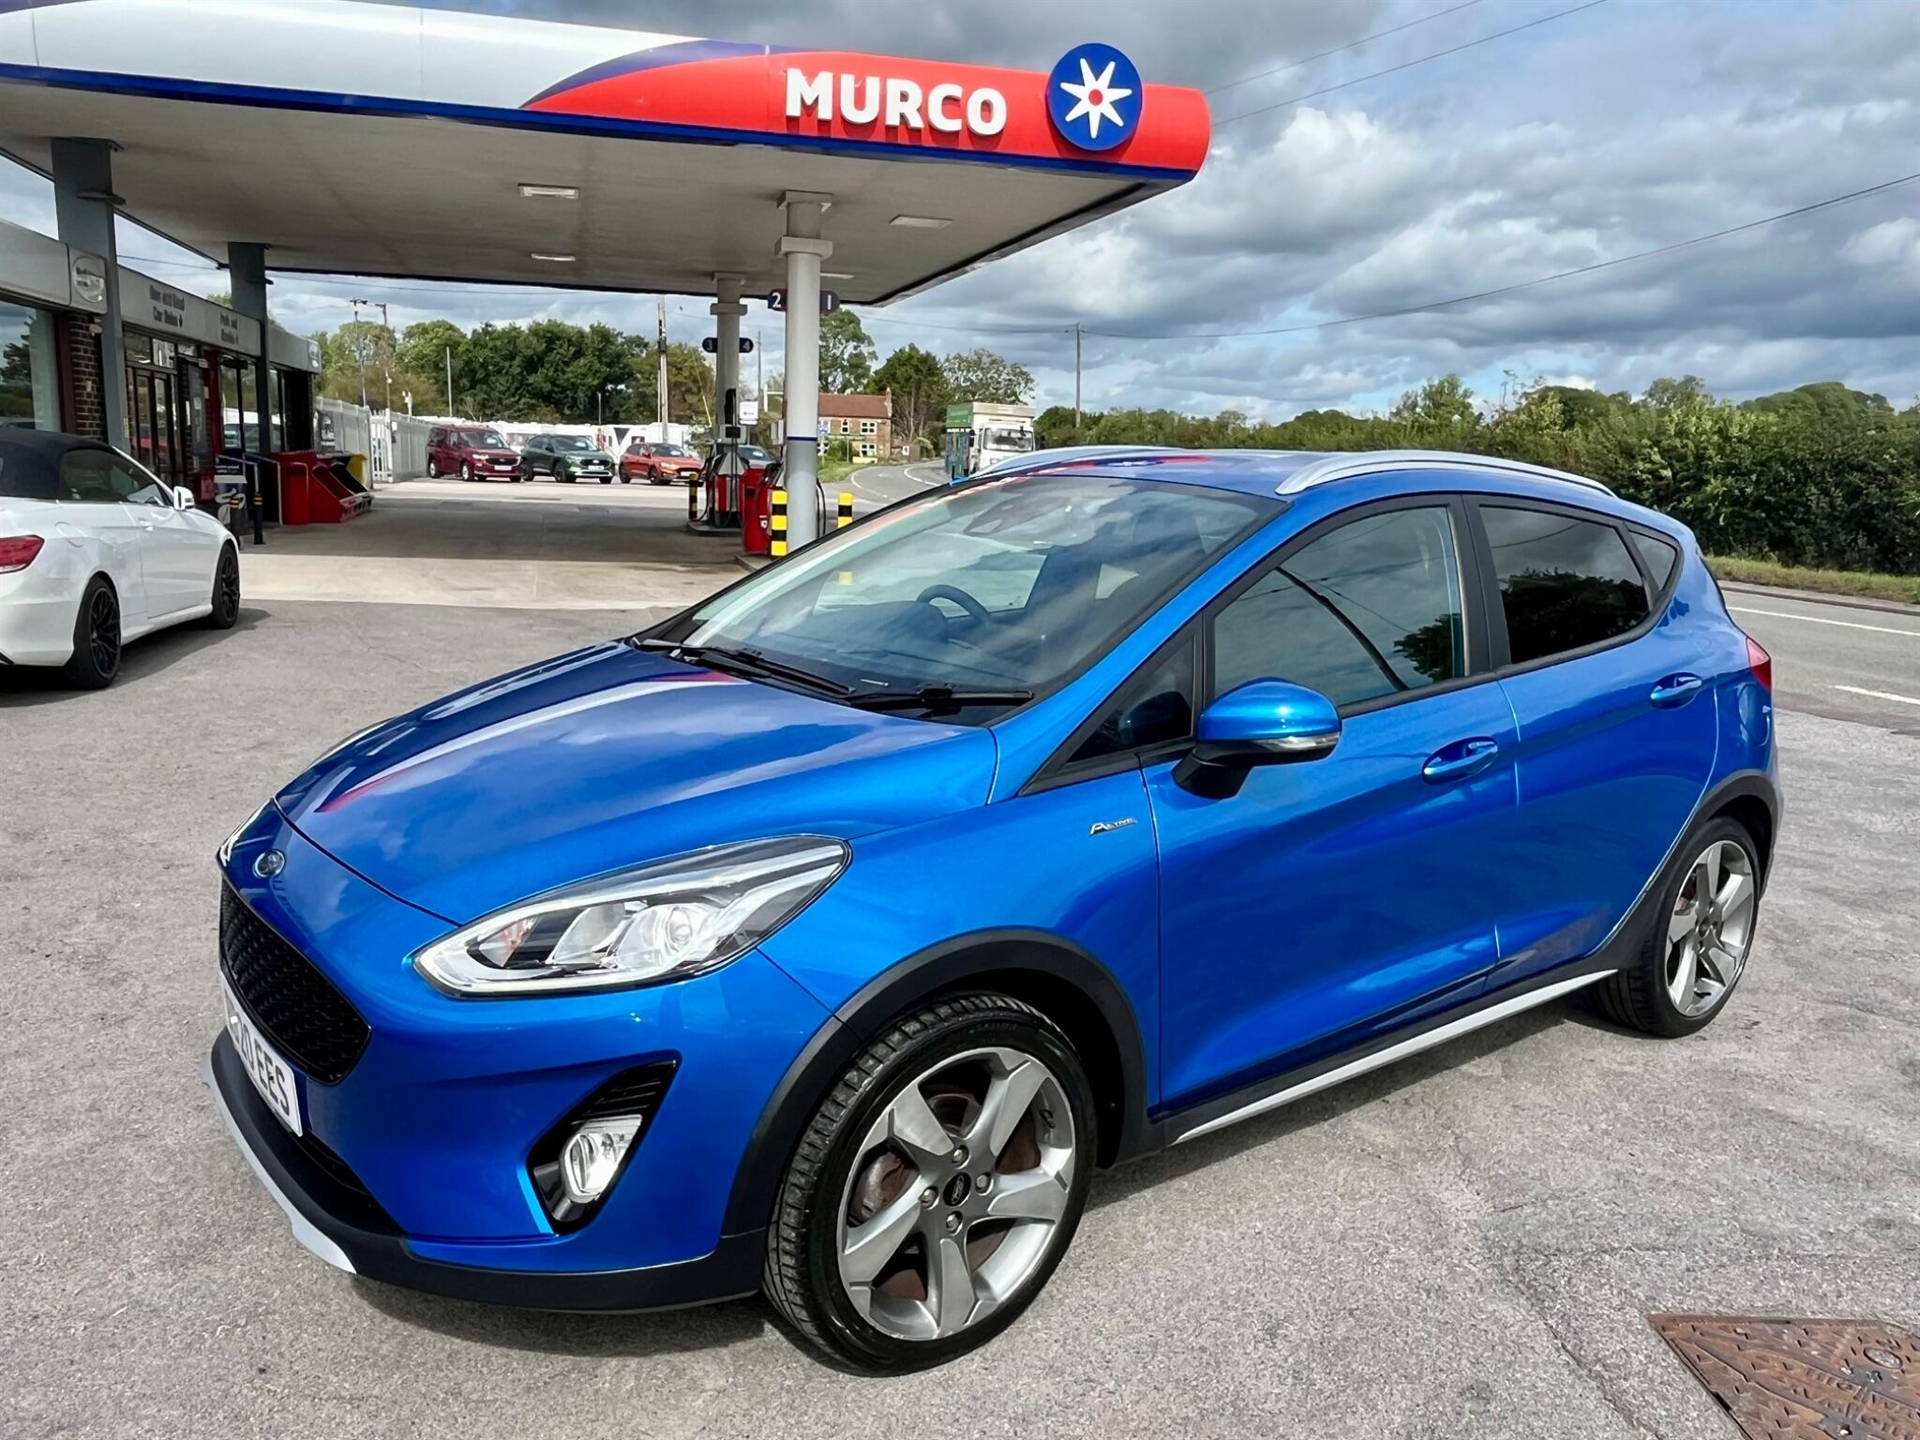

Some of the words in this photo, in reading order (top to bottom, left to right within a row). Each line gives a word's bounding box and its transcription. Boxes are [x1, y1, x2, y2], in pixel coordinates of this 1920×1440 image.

[785, 67, 1008, 136] MURCO
[771, 291, 782, 308] 2
[706, 340, 713, 351] 3
[743, 340, 750, 351] 4
[253, 1037, 290, 1117] EES
